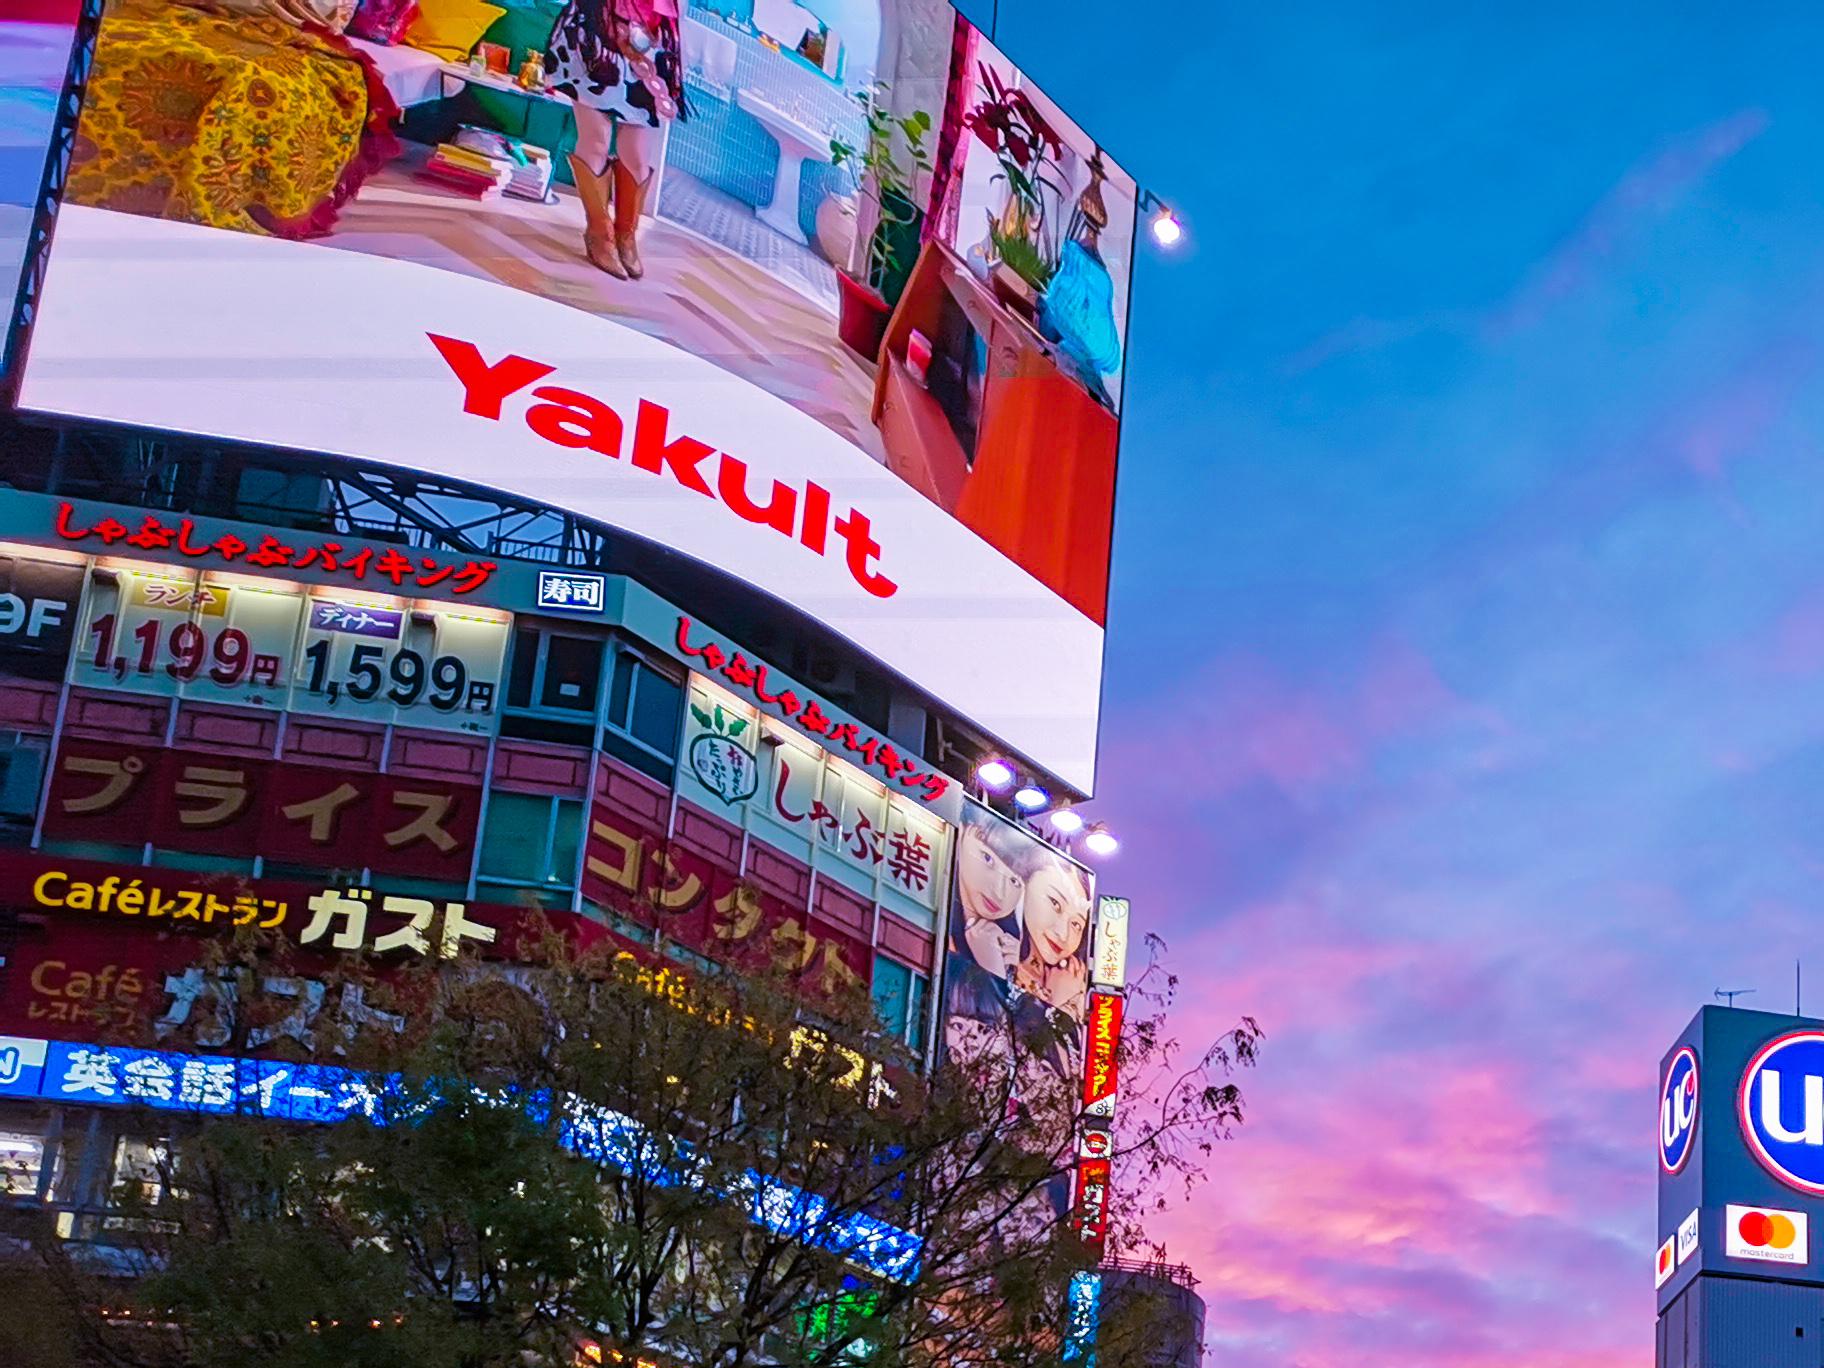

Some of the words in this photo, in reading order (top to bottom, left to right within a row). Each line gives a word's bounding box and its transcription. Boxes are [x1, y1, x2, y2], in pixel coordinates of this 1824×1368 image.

[425, 331, 899, 598] Yakult
[56, 501, 498, 594] しゃぶしゃぶバイキング
[319, 606, 395, 631] ディナー
[543, 576, 601, 606] 寿司
[675, 616, 950, 803] しゃぶしゃぶバイキング
[63, 755, 459, 854] プライス
[773, 758, 932, 892] しゃぶ葉
[299, 888, 497, 959] ガスト
[30, 960, 144, 1000] Café
[1740, 1248, 1795, 1260] mastercard
